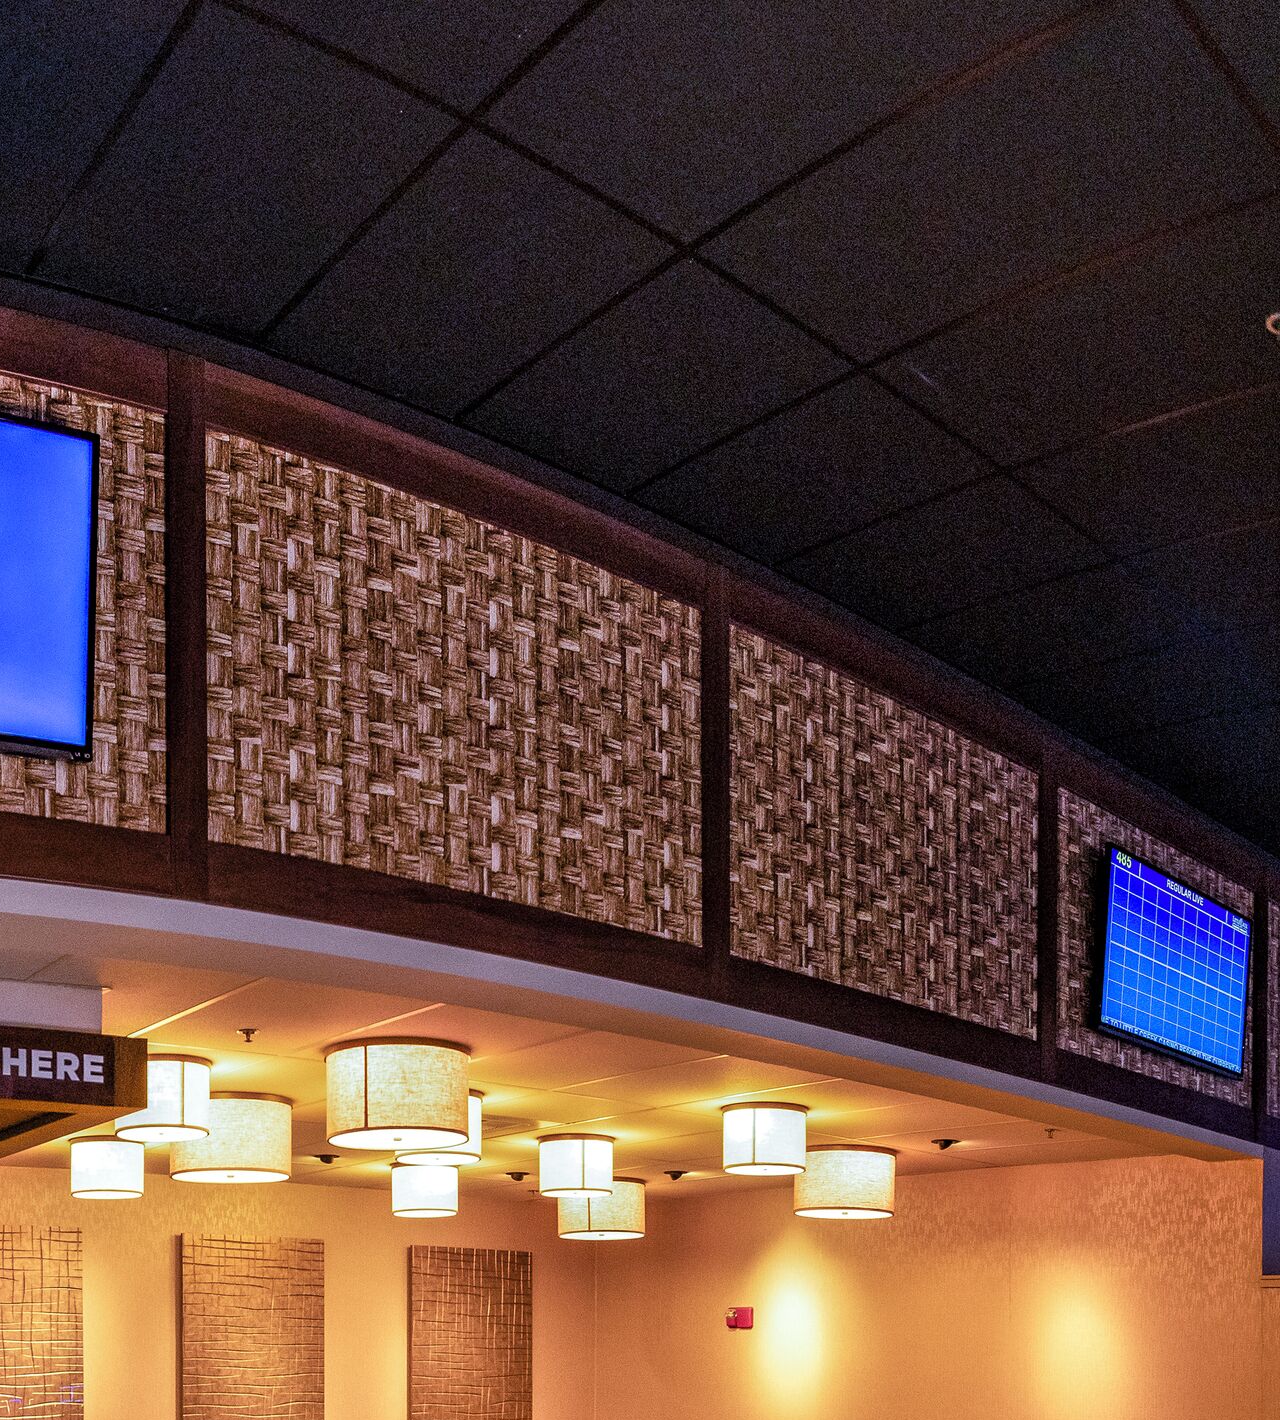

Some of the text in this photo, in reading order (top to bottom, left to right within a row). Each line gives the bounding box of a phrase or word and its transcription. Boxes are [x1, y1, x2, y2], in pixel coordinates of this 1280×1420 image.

[1116, 851, 1132, 869] 485
[1166, 879, 1204, 908] REGULAR LIVE
[2, 1046, 105, 1084] HERE
